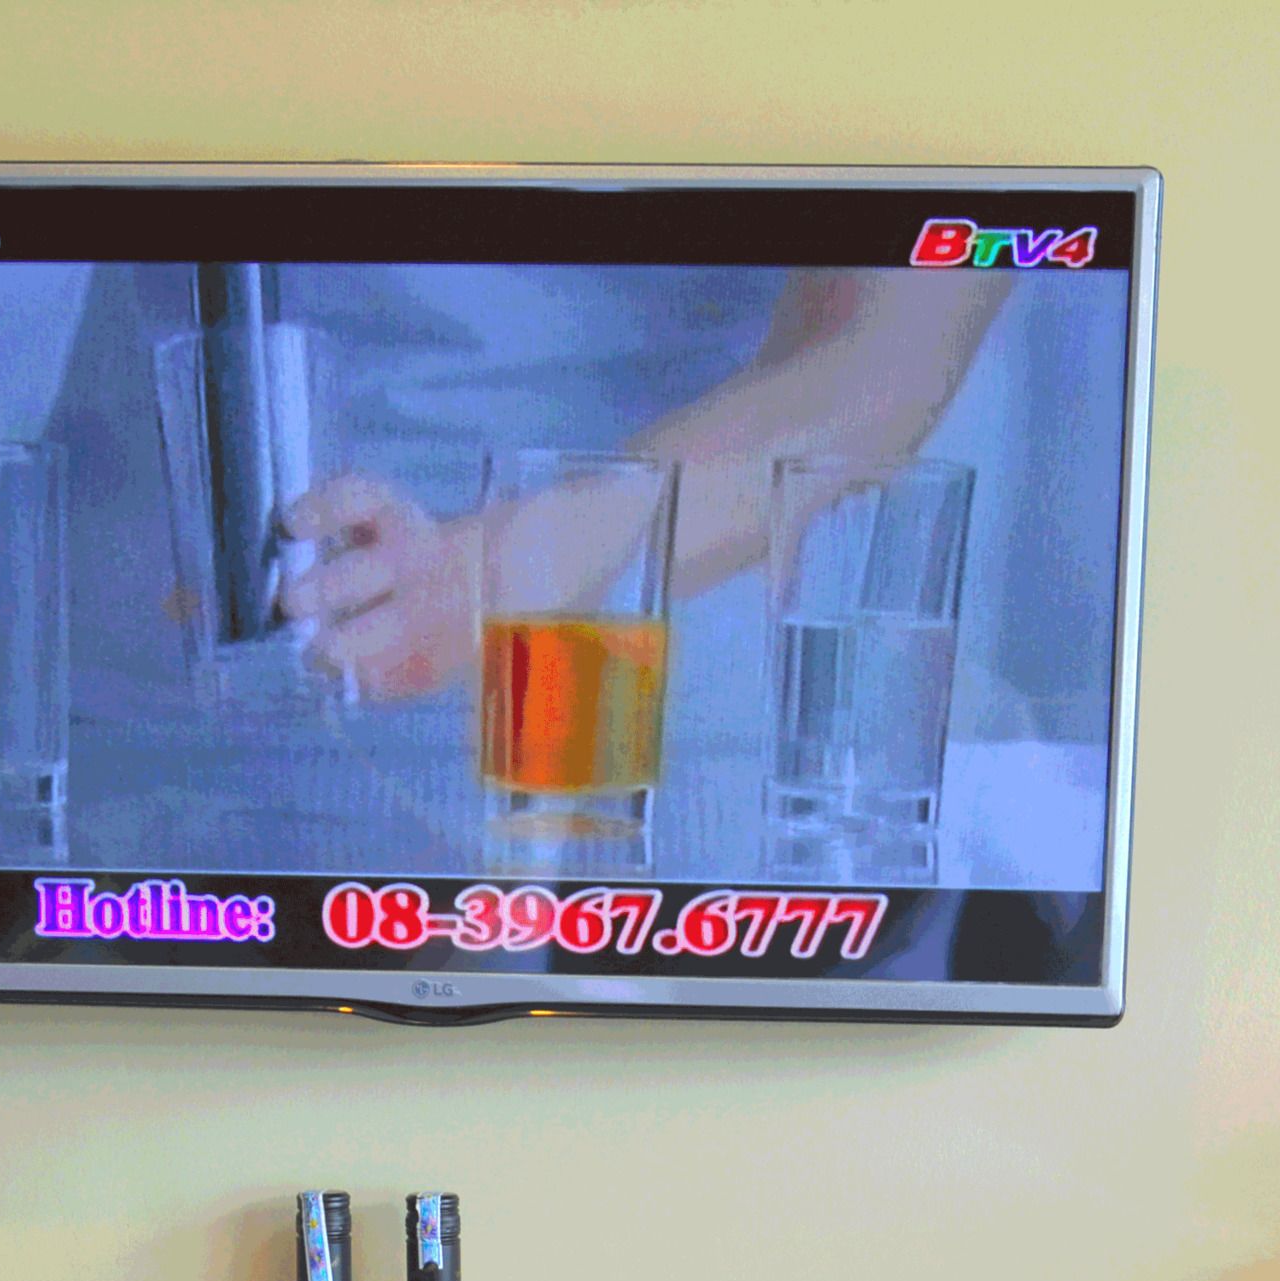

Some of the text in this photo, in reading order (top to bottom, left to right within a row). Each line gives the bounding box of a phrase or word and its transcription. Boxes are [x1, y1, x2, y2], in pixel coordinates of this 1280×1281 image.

[909, 217, 1099, 268] BTV4
[34, 877, 889, 960] Hotline: 08-3967.6777
[433, 983, 454, 997] LG
